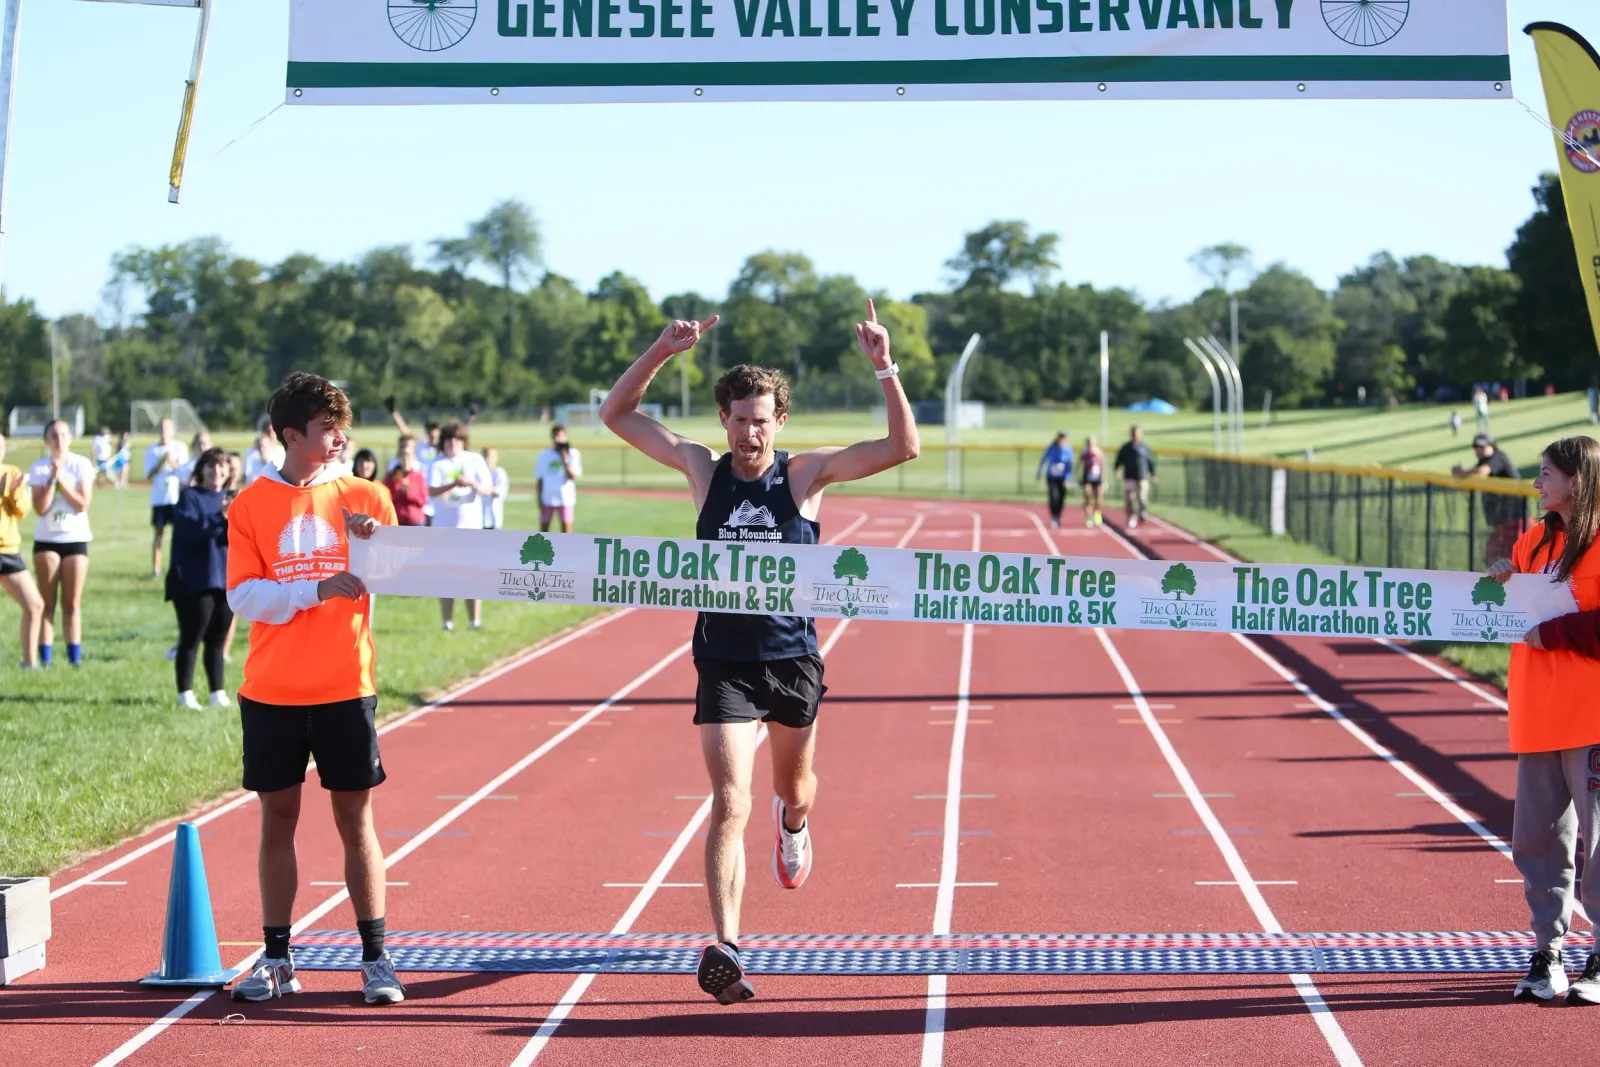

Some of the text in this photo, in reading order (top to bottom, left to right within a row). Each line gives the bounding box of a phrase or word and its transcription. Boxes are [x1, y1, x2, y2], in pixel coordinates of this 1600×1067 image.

[498, 0, 715, 38] GENESEE
[733, 0, 915, 38] VALLEY
[718, 528, 782, 540] Blue Mountain
[274, 565, 294, 576] THE
[318, 562, 346, 570] TREE
[594, 538, 796, 585] The Oak Tree
[914, 552, 1116, 598] The Oak Tree
[500, 572, 575, 588] The Oak Tree
[592, 578, 795, 612] Half Marathon & 5K
[813, 586, 889, 603] The Oak Tree
[1232, 567, 1432, 610] The Oak Tree
[914, 593, 1117, 625] Half Marathon & 5K
[1141, 601, 1216, 616] The Oak Tree
[1232, 606, 1432, 636] Half Marathon & 5K
[1453, 612, 1526, 628] The Oak Tree
